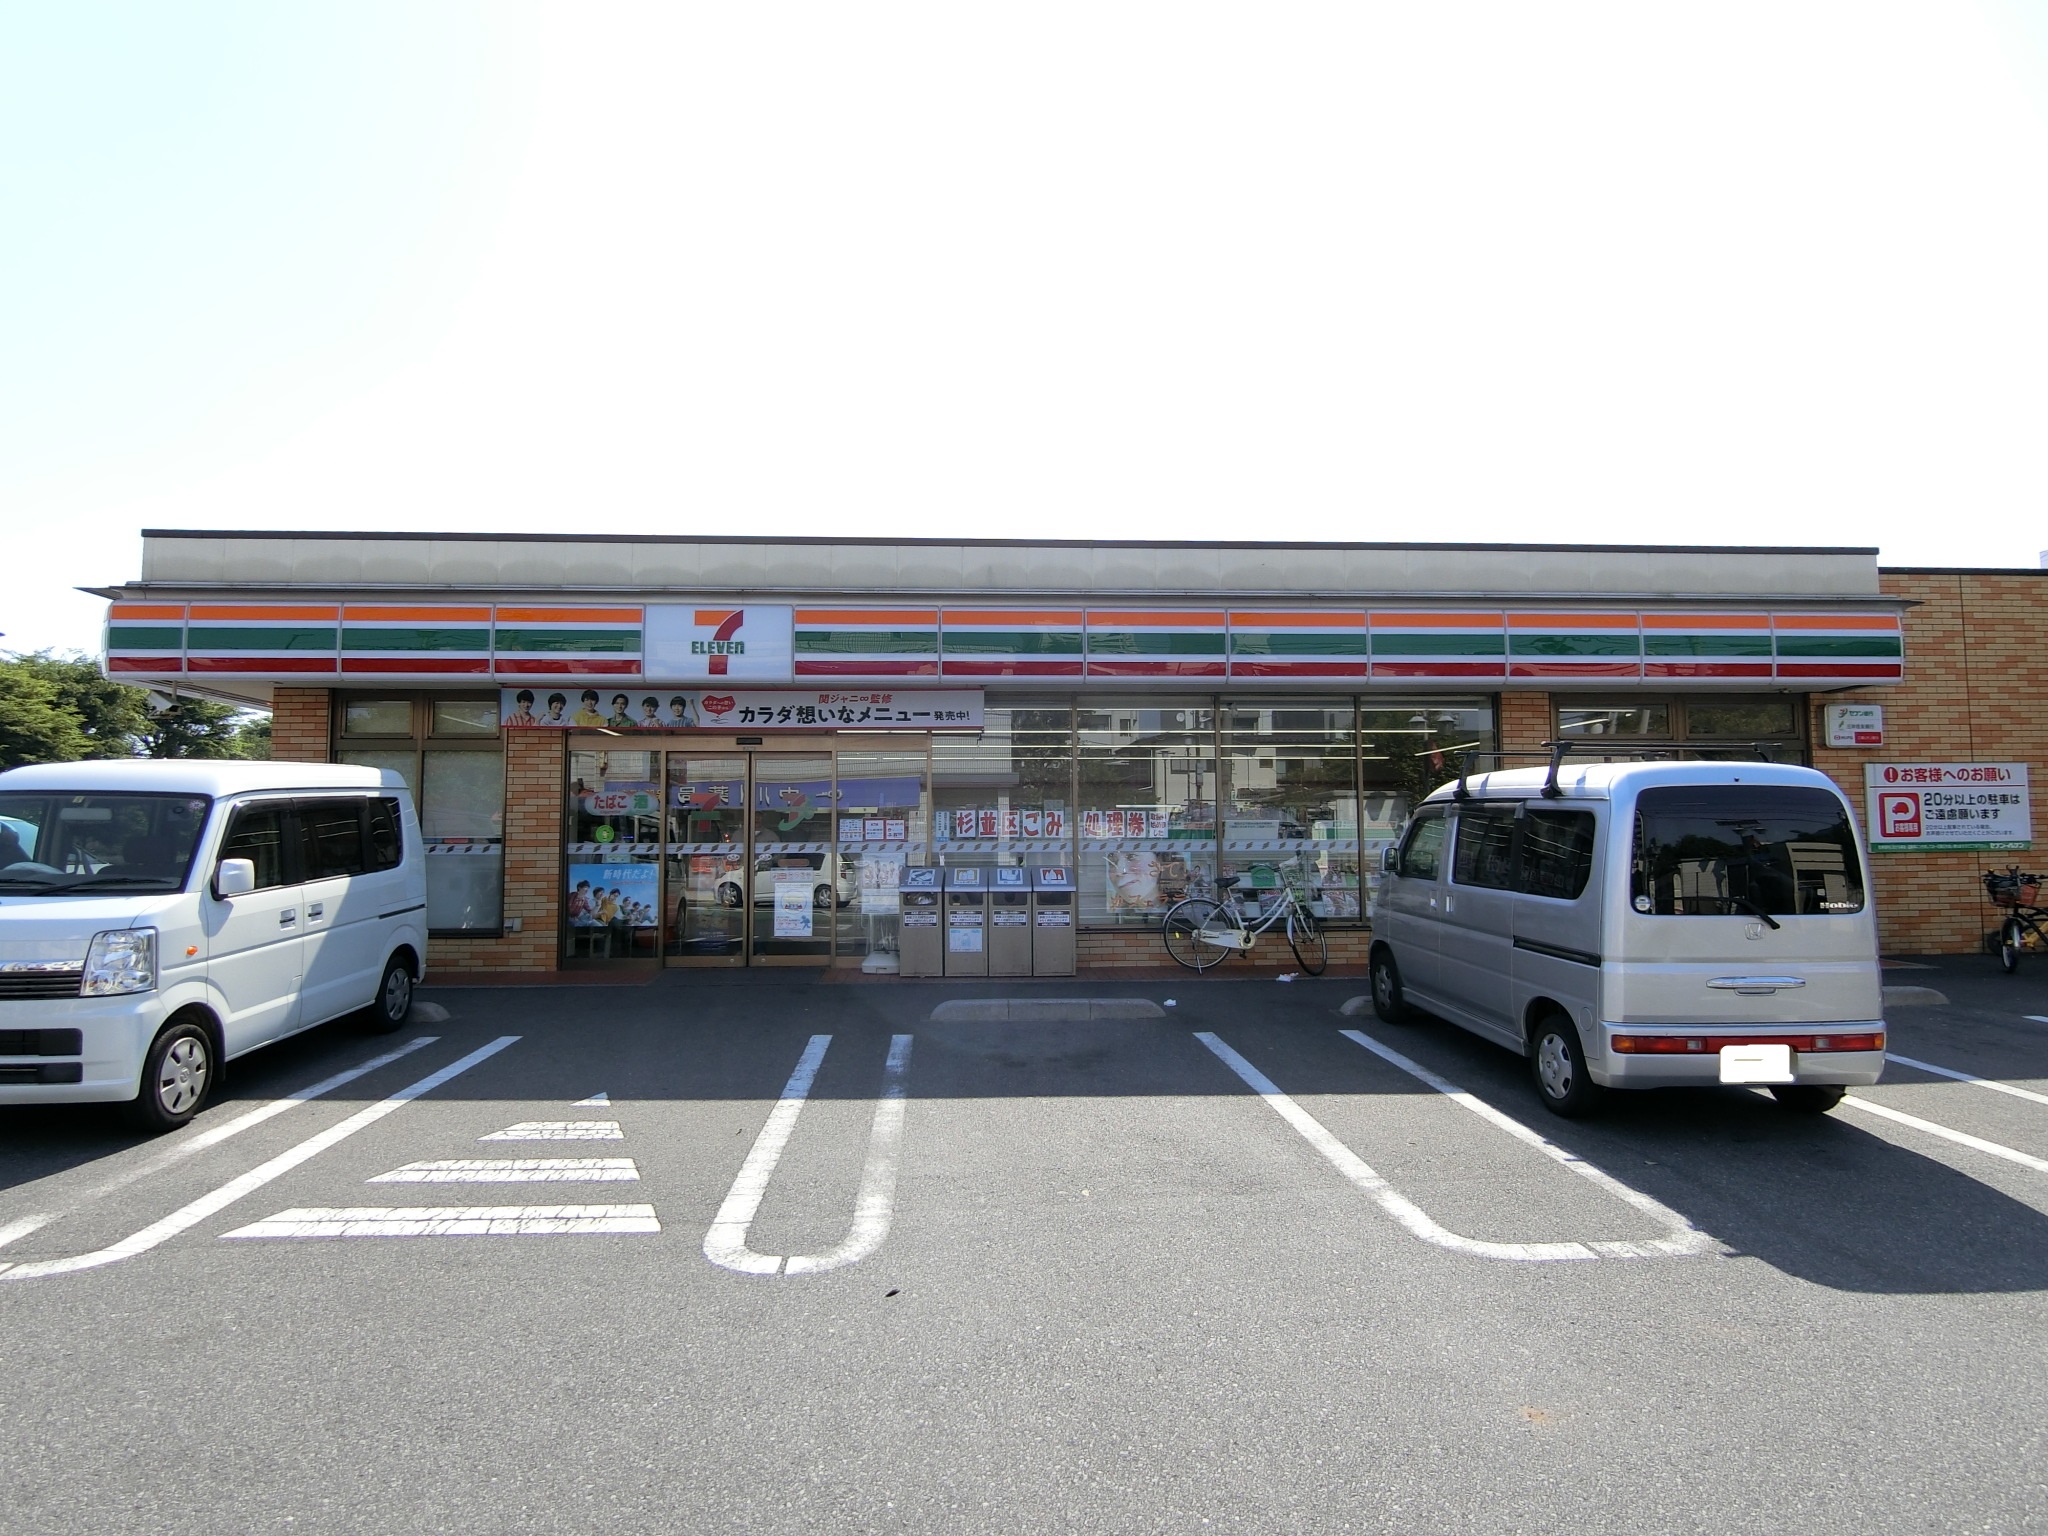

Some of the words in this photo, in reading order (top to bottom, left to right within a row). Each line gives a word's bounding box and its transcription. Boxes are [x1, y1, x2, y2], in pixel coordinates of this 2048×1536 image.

[818, 693, 893, 704] 関ジャニ∞監修
[738, 705, 931, 724] カラダ想いなメニュー
[1900, 767, 2011, 782] お客様へのお願い
[594, 794, 627, 809] たばこ
[633, 794, 649, 809] 酒
[1923, 792, 2021, 806] 20分以上の駐車は
[1924, 808, 2001, 820] ご遠慮願います
